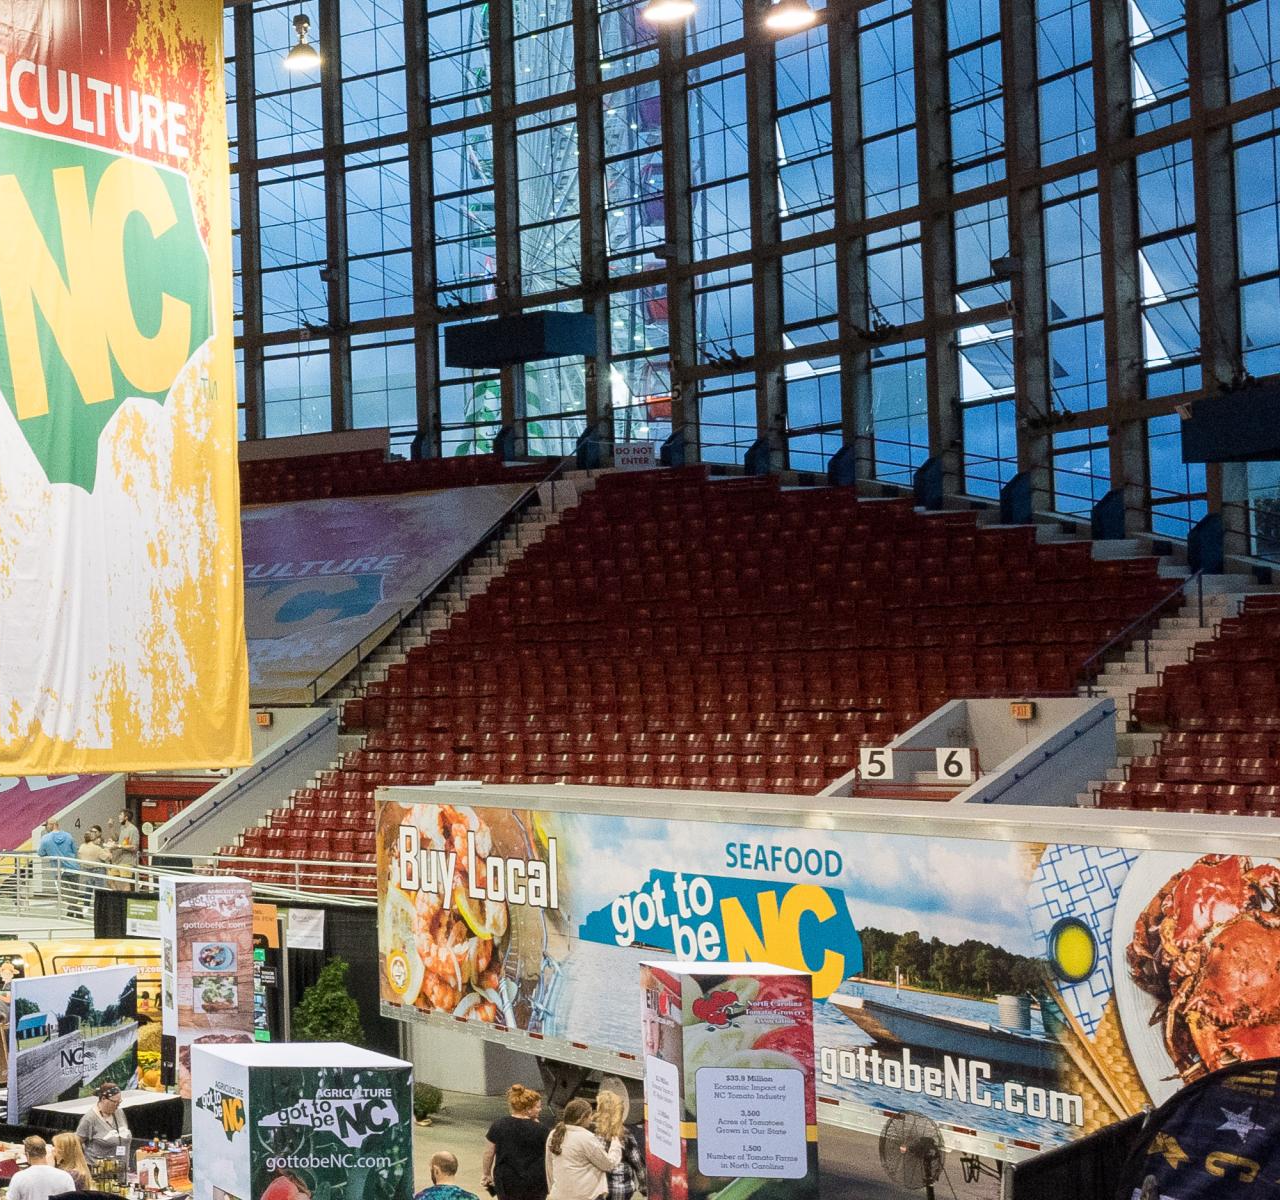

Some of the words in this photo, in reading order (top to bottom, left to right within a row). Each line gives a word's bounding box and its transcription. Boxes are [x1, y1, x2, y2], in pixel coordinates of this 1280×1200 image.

[616, 447, 630, 455] DO
[621, 457, 649, 465] ENTER
[868, 750, 886, 777] 5
[944, 750, 963, 777] 6
[74, 818, 81, 829] 4
[398, 824, 457, 910] Buy
[466, 830, 558, 909] Local
[725, 841, 843, 878] SEAFOOD
[611, 877, 670, 946] got
[673, 871, 713, 916] to
[183, 920, 246, 930] gottobeNC.com
[671, 914, 721, 961] be
[720, 884, 845, 999] NC
[60, 1050, 83, 1068] NC
[215, 1081, 244, 1097] AGRICULTURE
[317, 1088, 392, 1097] AGRICULTURE
[714, 1083, 749, 1091] Economic
[751, 1084, 777, 1093] Impact
[820, 1045, 1084, 1127] gottobeNC.com
[201, 1093, 215, 1108] got
[214, 1090, 222, 1102] to
[756, 1092, 787, 1101] Industry
[213, 1105, 222, 1118] be
[222, 1098, 244, 1132] NC
[278, 1104, 309, 1126] got
[312, 1099, 331, 1114] to
[335, 1099, 391, 1139] NC
[310, 1113, 334, 1128] be
[749, 1119, 784, 1127] Tomatoes
[716, 1127, 740, 1135] Grown
[742, 1127, 750, 1135] in
[751, 1127, 765, 1135] Our
[767, 1128, 787, 1136] State
[706, 1153, 735, 1161] Number
[746, 1154, 774, 1162] Tomato
[742, 1145, 761, 1153] 1,500
[266, 1154, 391, 1172] gottobeNC.com
